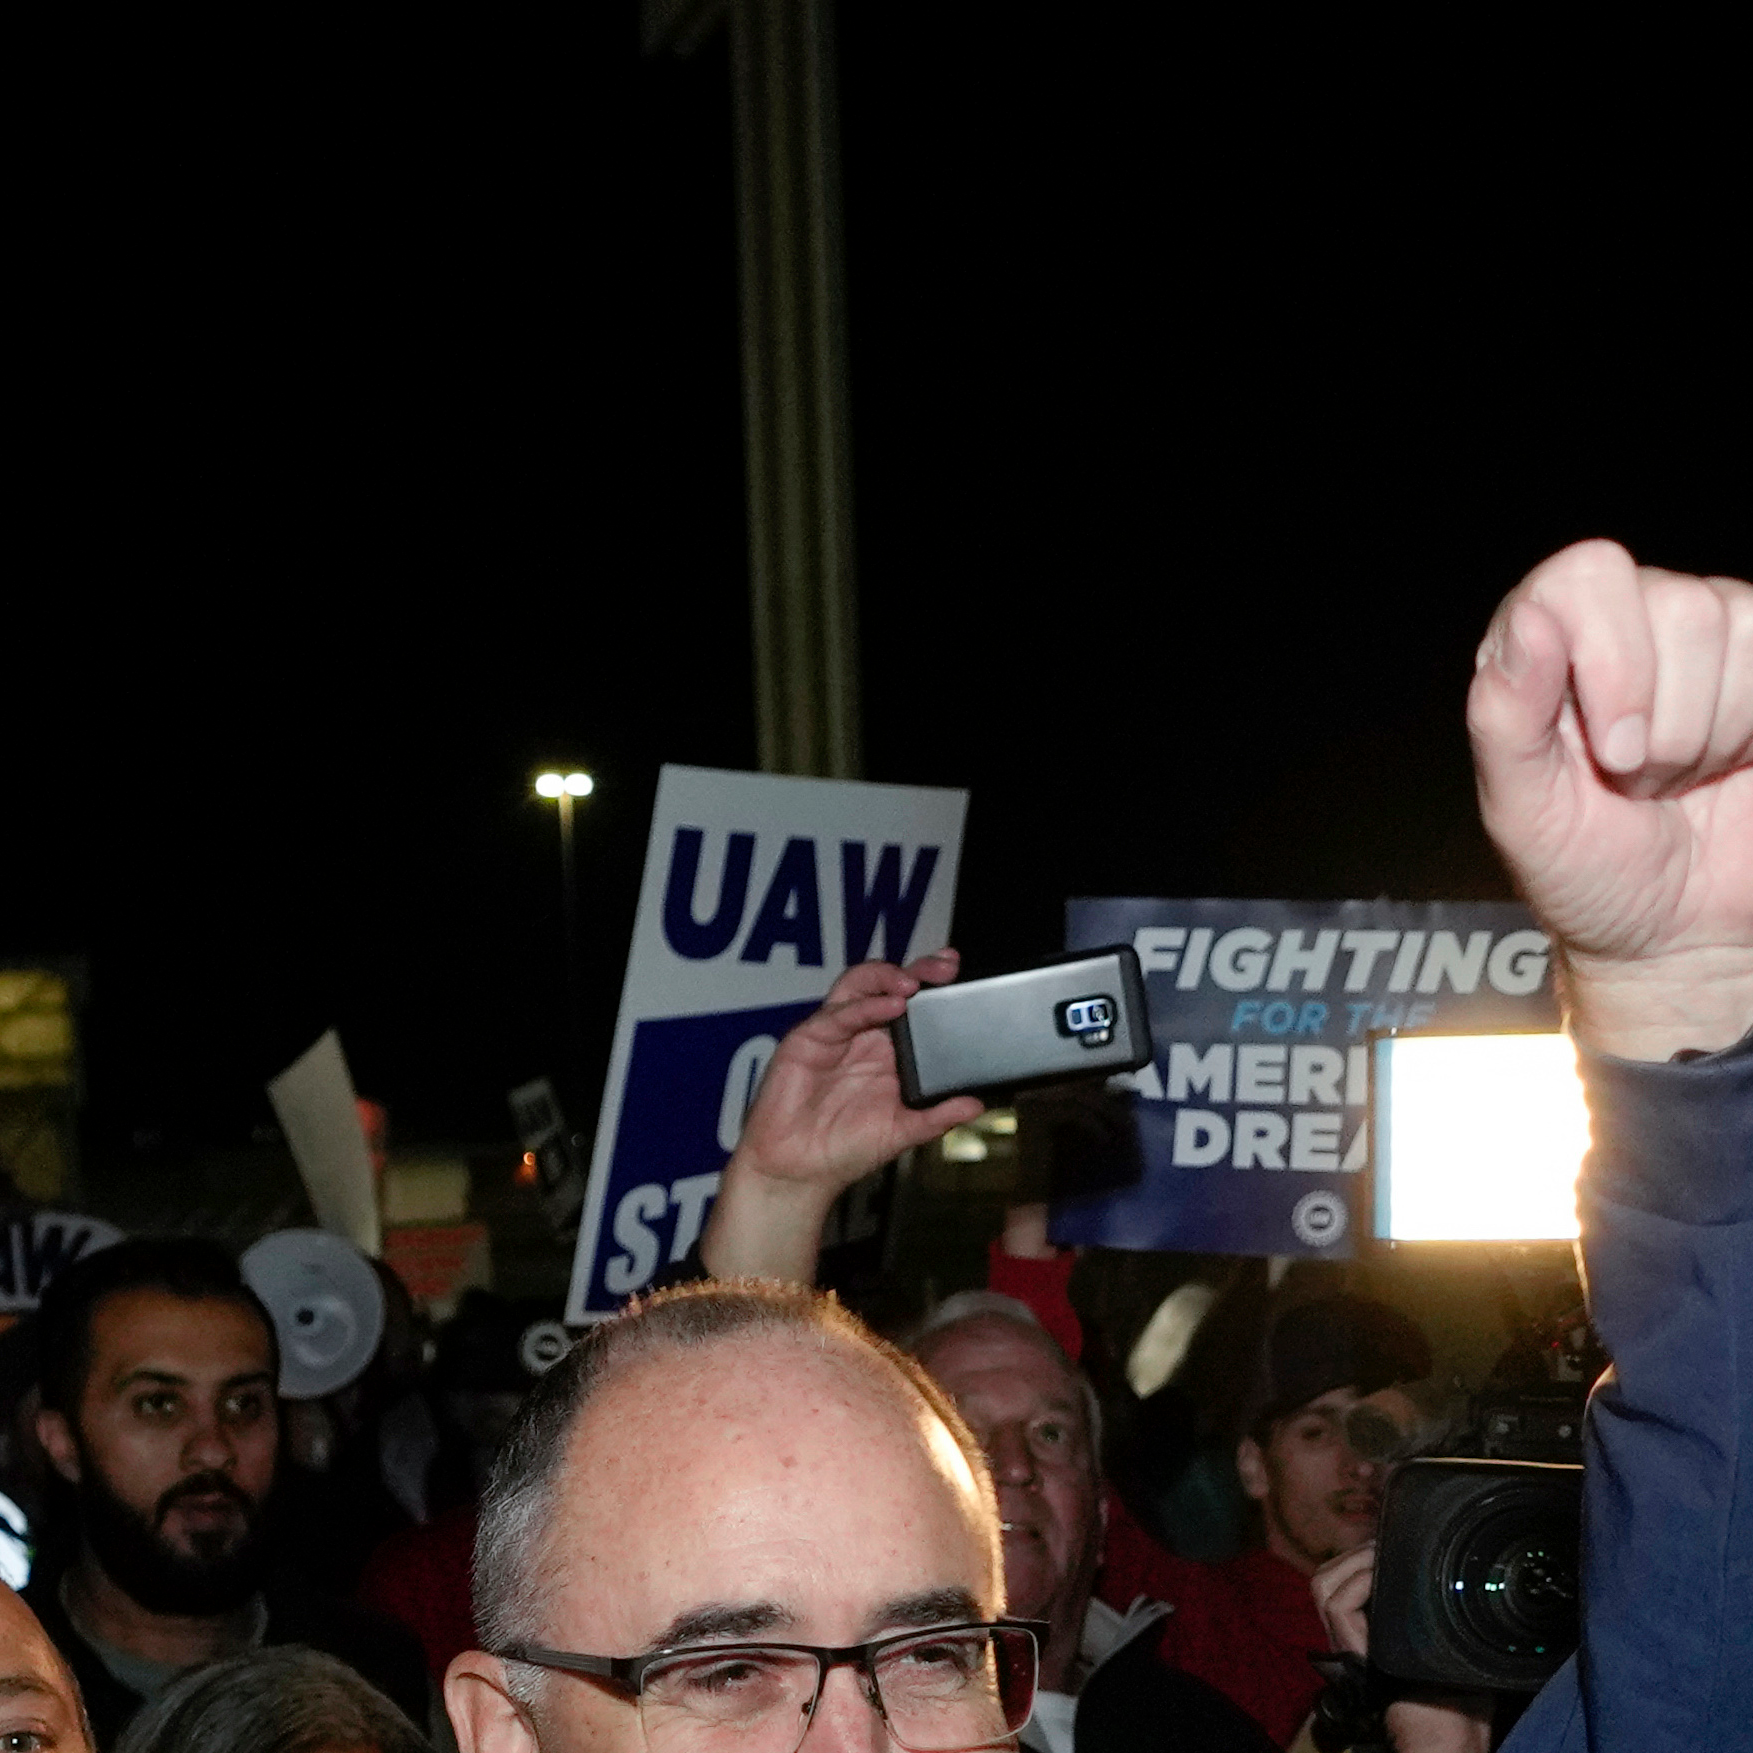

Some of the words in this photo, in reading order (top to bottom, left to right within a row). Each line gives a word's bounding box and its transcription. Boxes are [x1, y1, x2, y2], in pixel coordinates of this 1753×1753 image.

[663, 827, 940, 967] UAW
[1133, 926, 1551, 995] FIGHTING
[1230, 1002, 1330, 1034] FOR
[1346, 1002, 1438, 1034] THE
